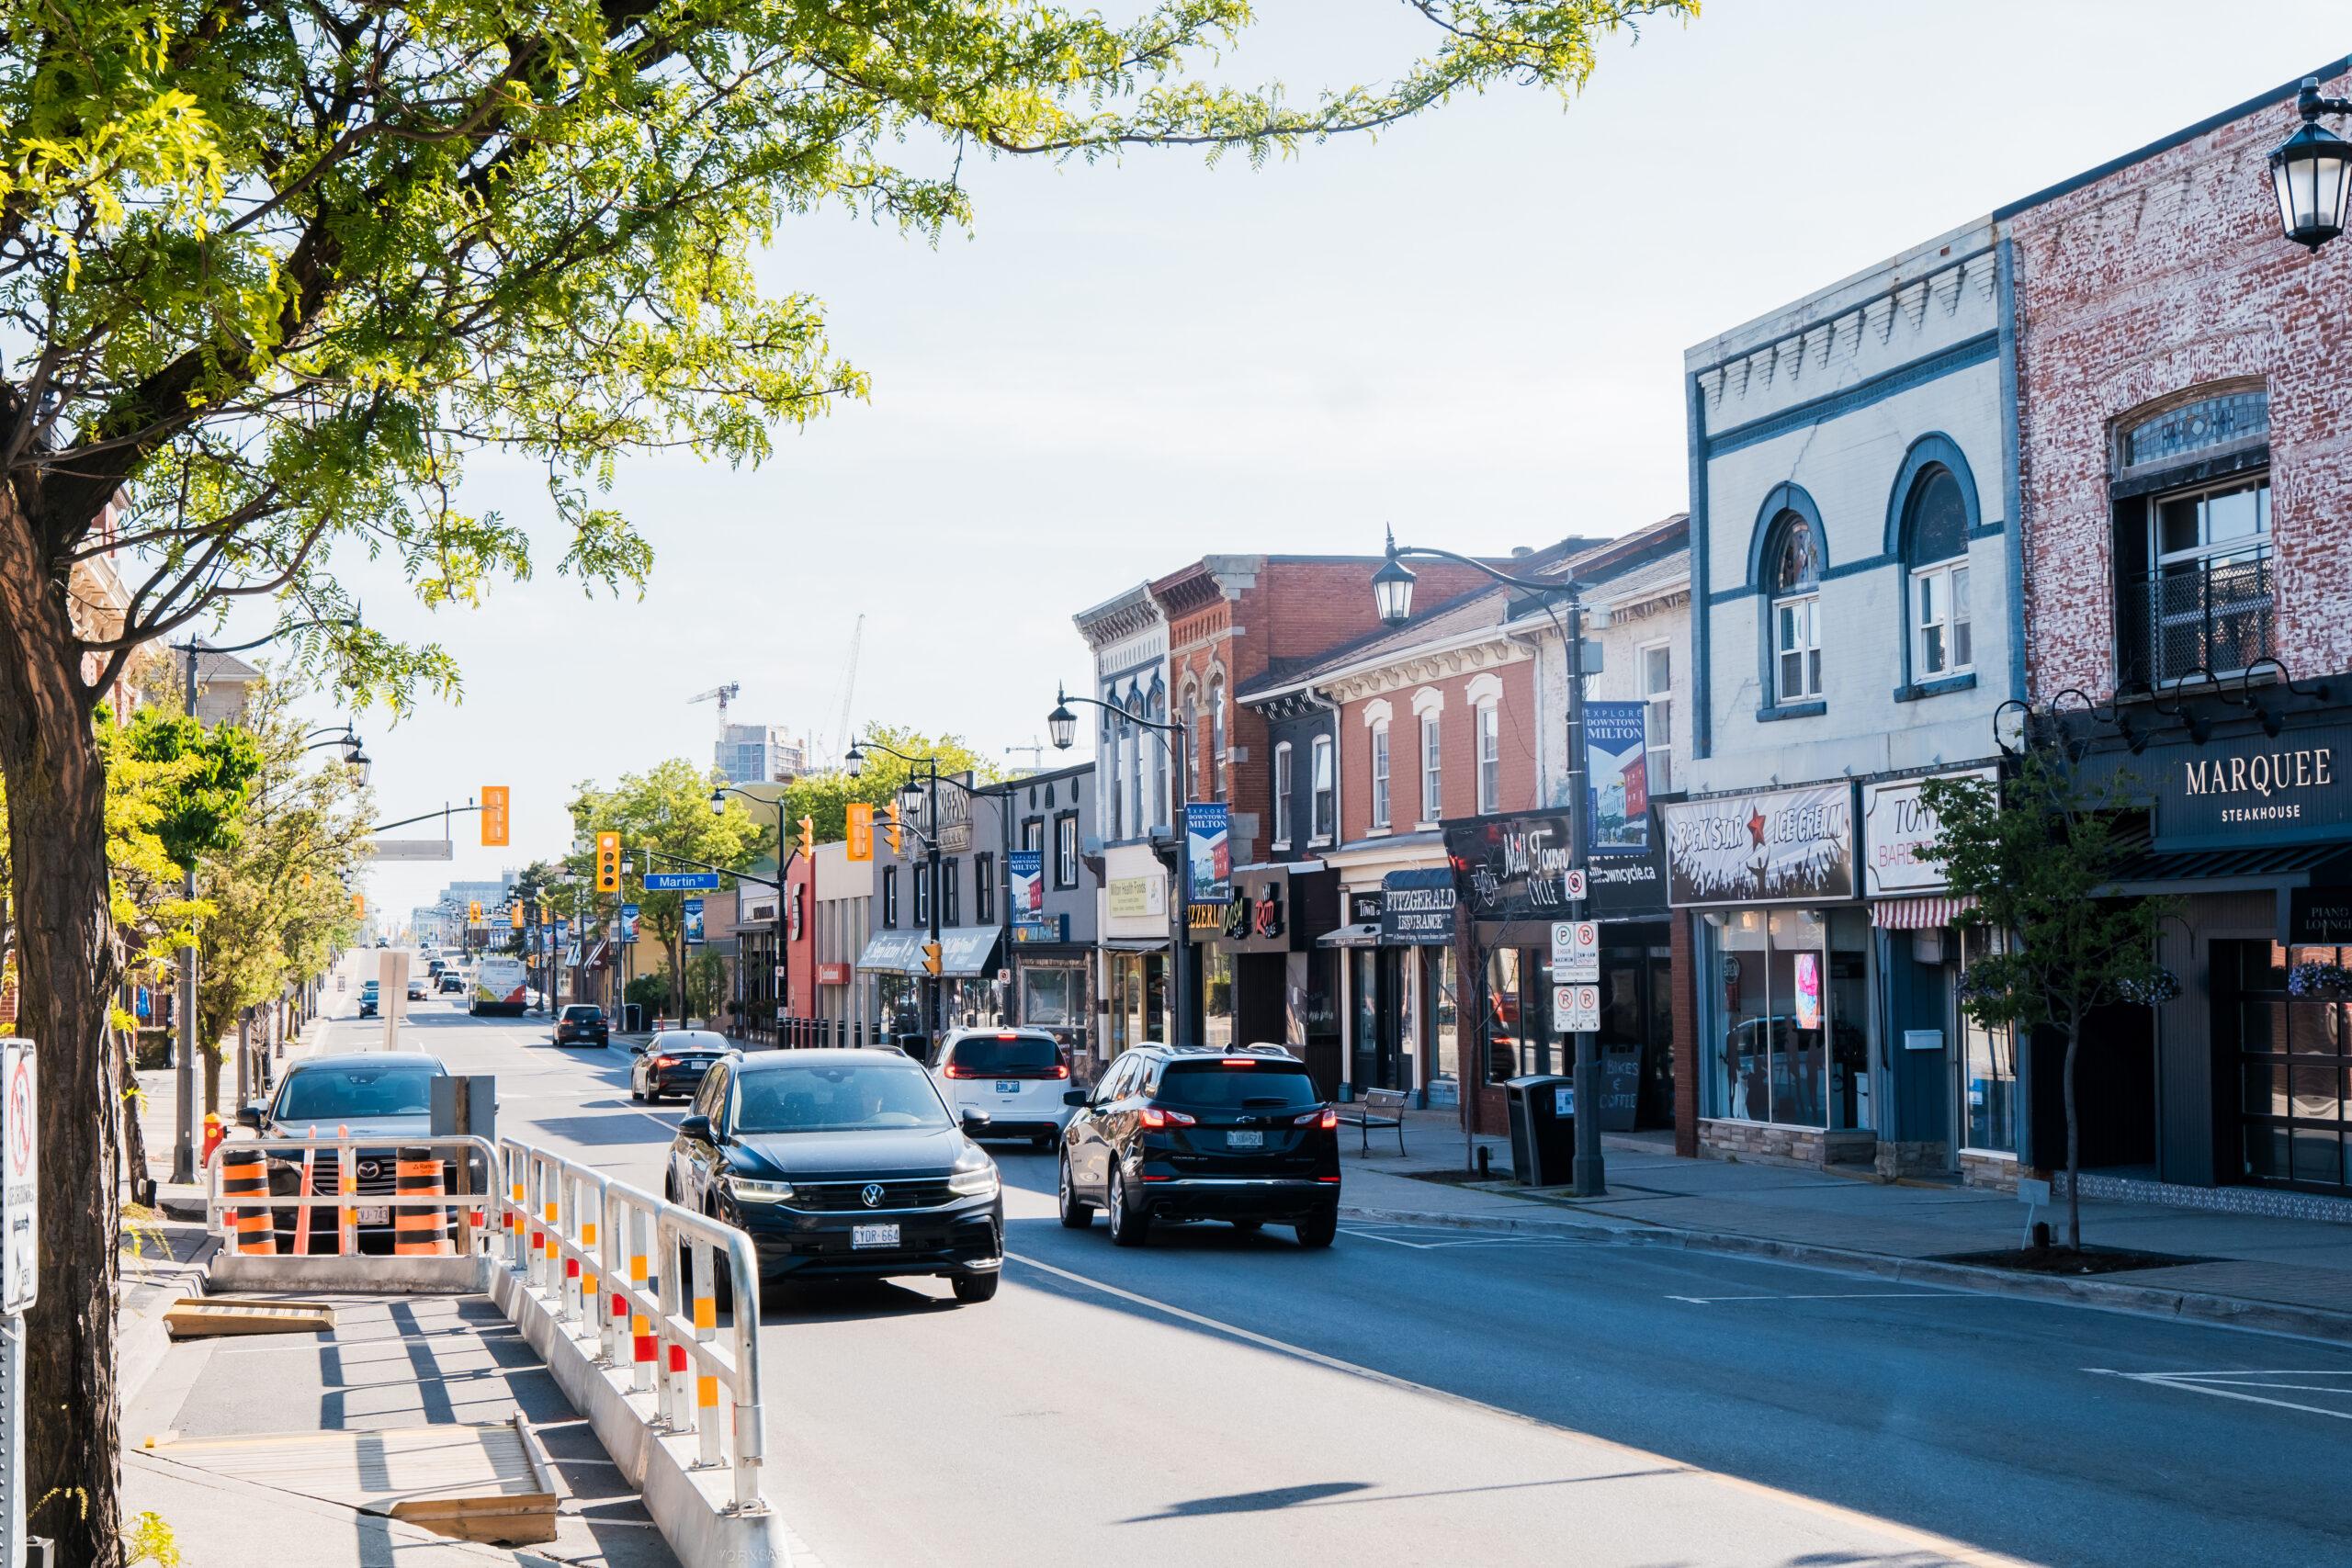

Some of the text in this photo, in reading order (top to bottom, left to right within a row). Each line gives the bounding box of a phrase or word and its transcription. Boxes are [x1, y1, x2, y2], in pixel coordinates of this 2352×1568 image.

[1588, 728, 1643, 739] MILTON
[2186, 749, 2331, 797] MARQUEE
[2222, 805, 2301, 822] STEAKHOUSE
[1189, 820, 1227, 829] MILTON
[1677, 803, 1844, 853] ROCK STAR ICE CREAM
[1501, 829, 1569, 878] Mill Town
[660, 876, 695, 887] Martin
[1385, 888, 1456, 912] FITZGERALD
[1527, 877, 1558, 906] CYCLE
[1223, 897, 1243, 937] DOSA
[2312, 907, 2349, 918] PIANO
[1397, 914, 1443, 930] INSURANCE
[881, 1229, 899, 1242] 664
